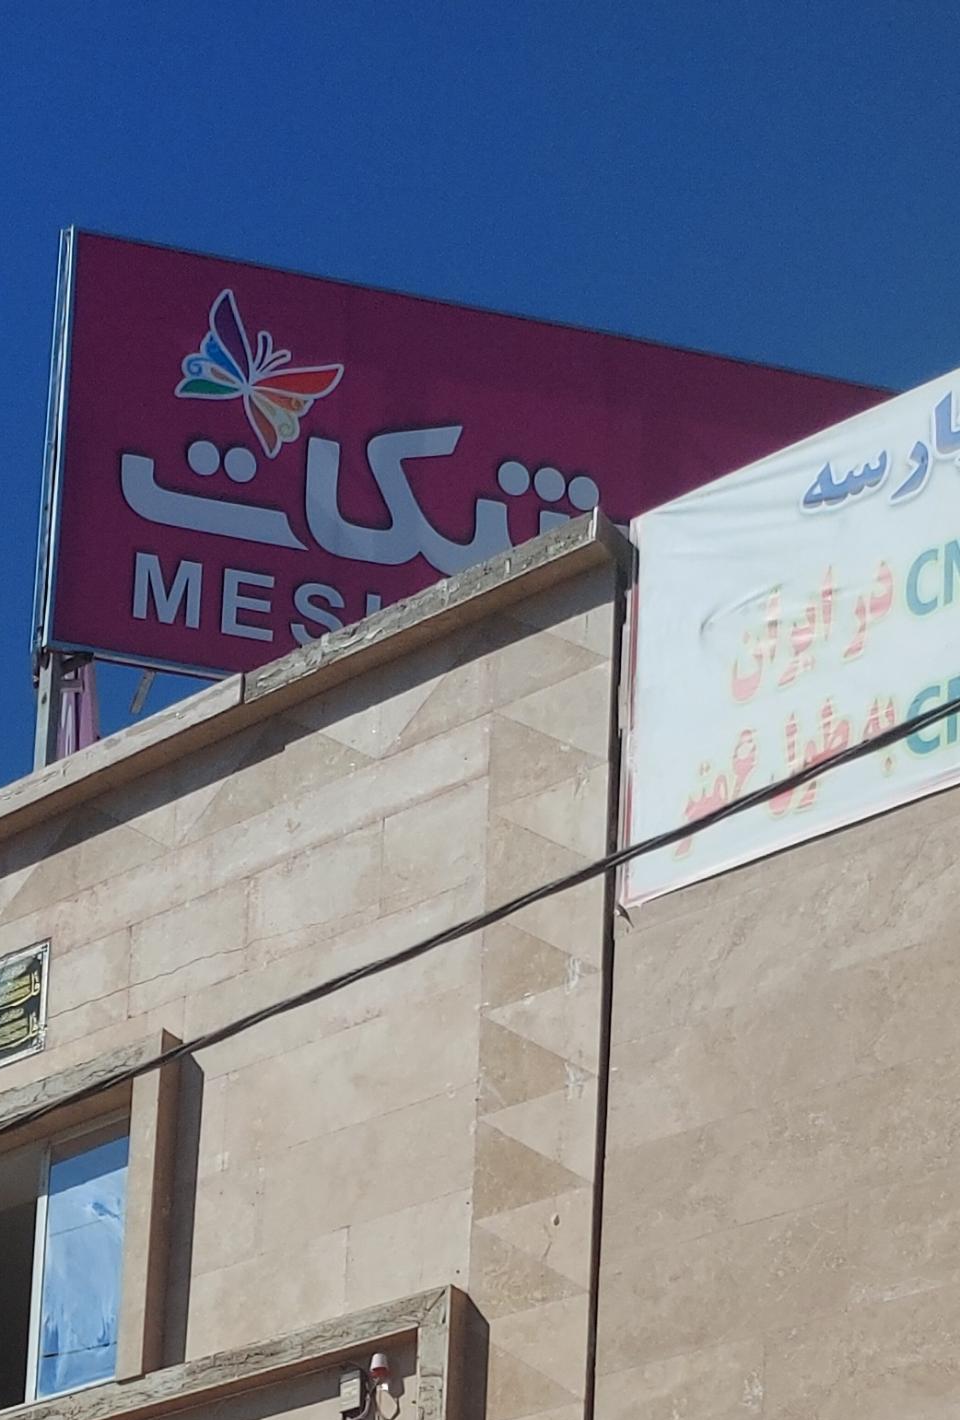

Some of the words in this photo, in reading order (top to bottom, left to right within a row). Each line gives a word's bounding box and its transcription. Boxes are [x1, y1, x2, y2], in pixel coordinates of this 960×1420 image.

[120, 424, 637, 577] شکات
[801, 392, 960, 512] ارسه
[132, 552, 385, 646] MES
